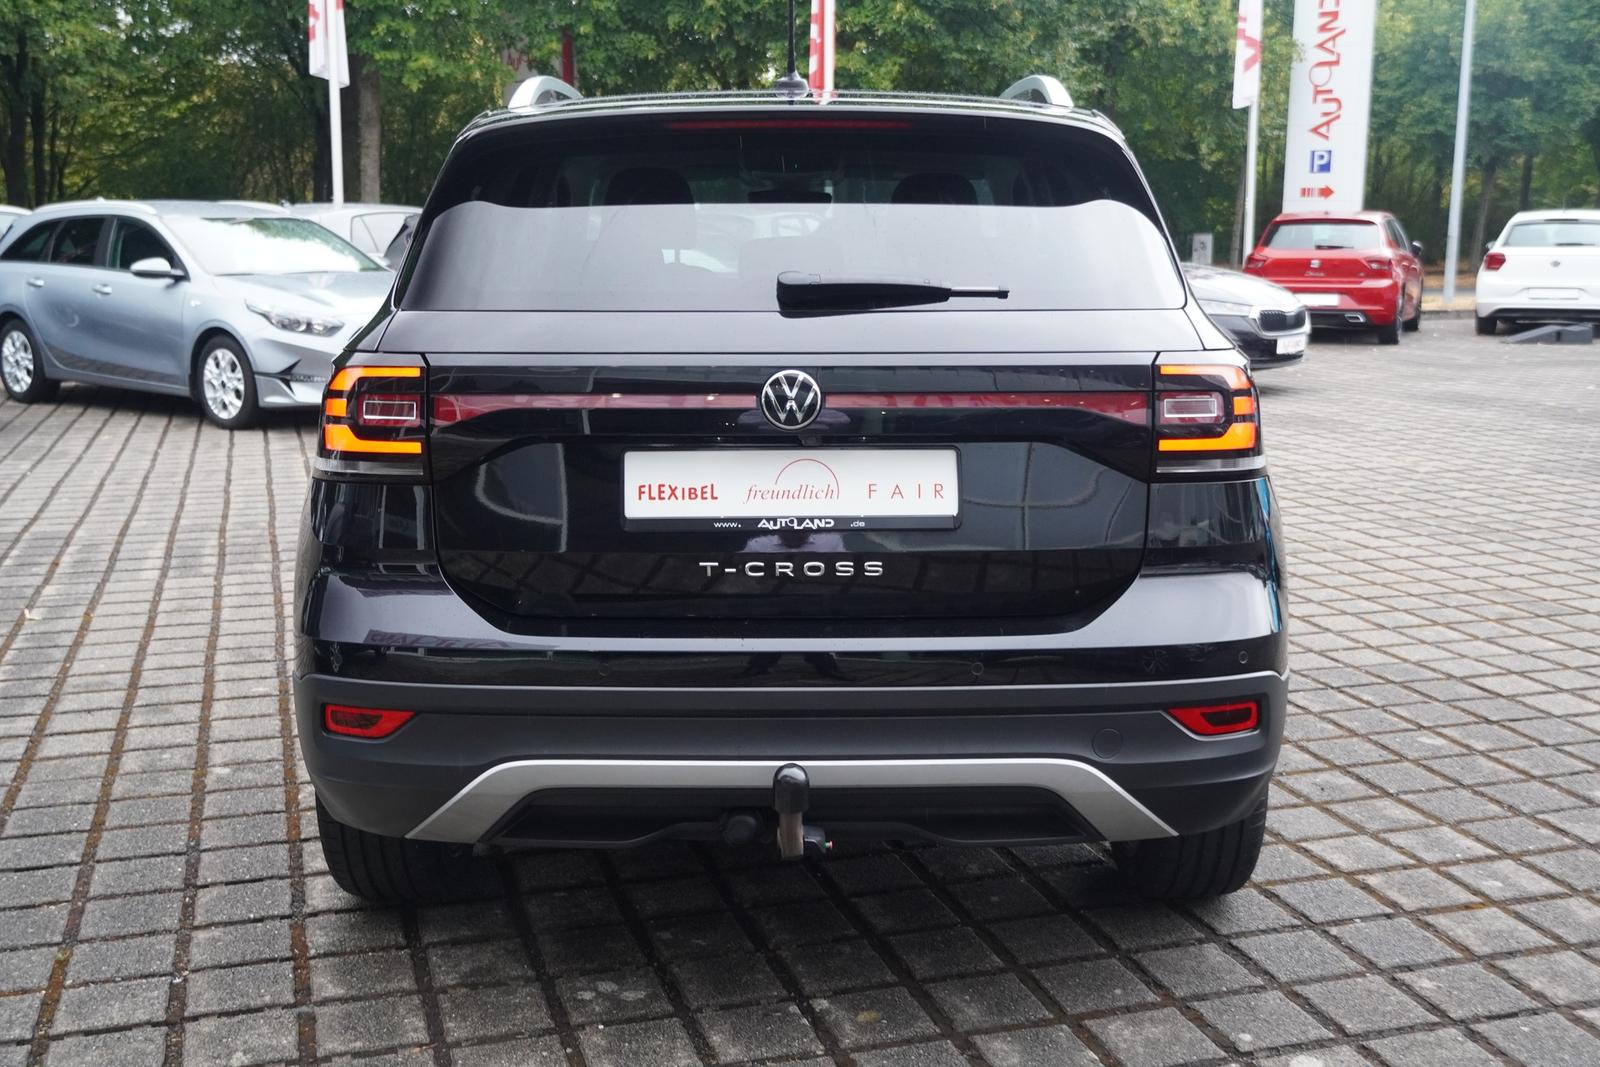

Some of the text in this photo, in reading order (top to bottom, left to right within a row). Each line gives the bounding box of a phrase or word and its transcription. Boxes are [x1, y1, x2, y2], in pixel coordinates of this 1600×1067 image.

[1313, 151, 1329, 173] P
[637, 483, 945, 505] FLEXIBEL freundlich FAIR
[757, 517, 835, 530] AUTOLAND
[698, 561, 884, 577] T-CROSS
